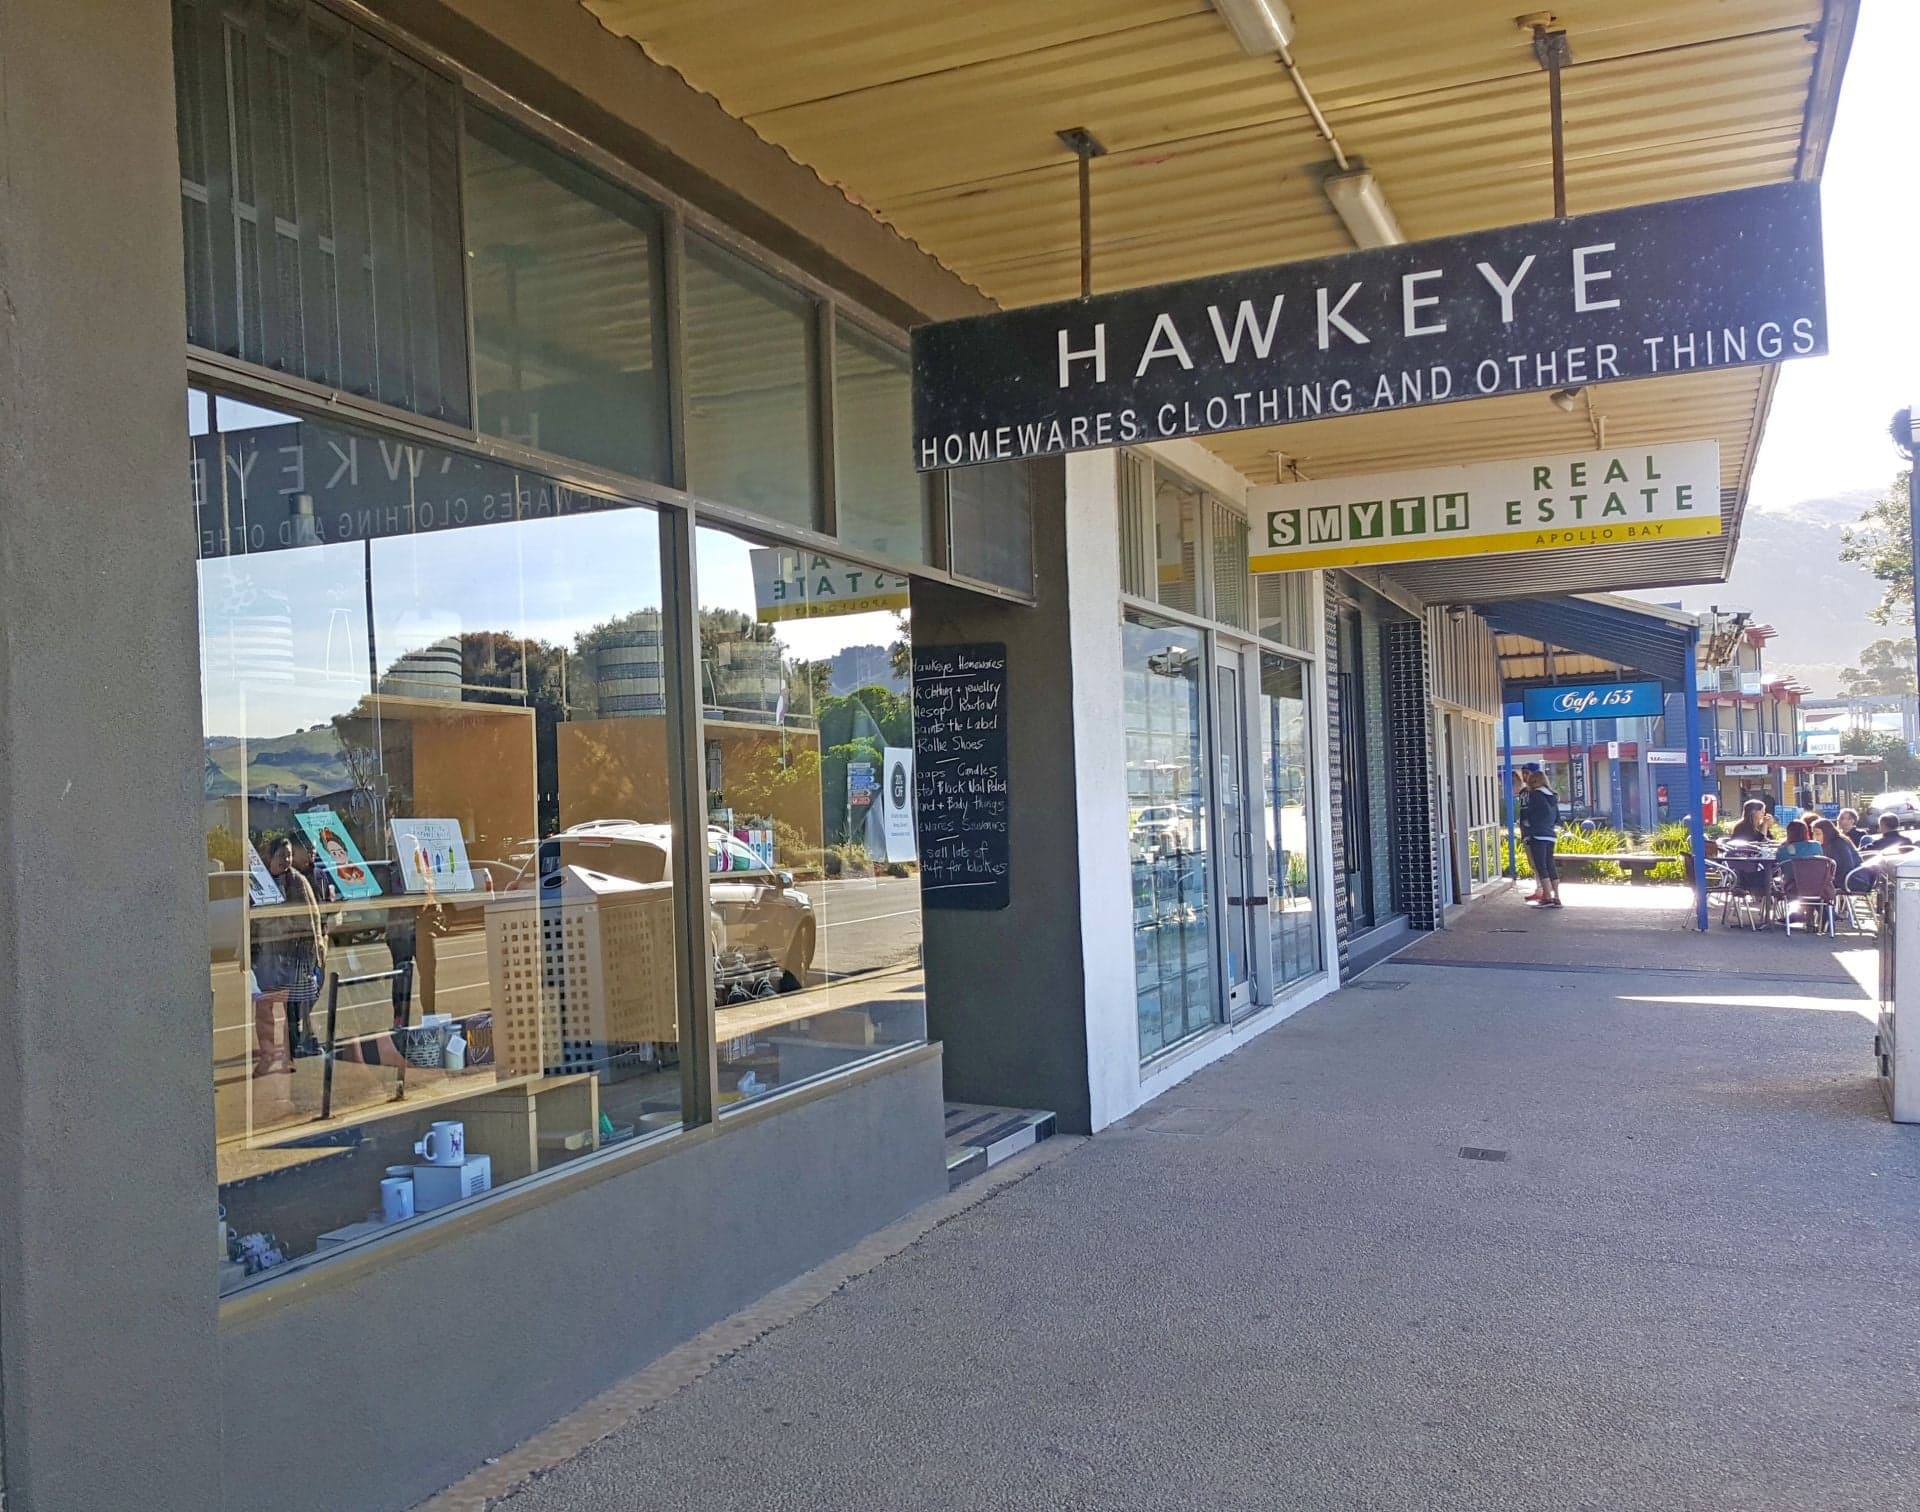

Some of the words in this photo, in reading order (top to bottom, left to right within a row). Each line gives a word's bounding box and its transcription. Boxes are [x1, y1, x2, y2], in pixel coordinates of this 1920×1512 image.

[1057, 242, 1621, 389] HAWKEYE
[921, 409, 1138, 468] HOMEWARES
[1157, 378, 1353, 437] CLOTHING
[1373, 365, 1453, 408] AND
[1476, 343, 1621, 394] OTHER
[1642, 317, 1816, 373] THINGS
[1532, 455, 1662, 492] REAL
[1266, 491, 1470, 549] SMYTH
[1506, 484, 1693, 526] ESTATE
[1535, 527, 1614, 545] APOLLO
[1627, 523, 1664, 538] BAY
[1553, 690, 1600, 714] Cafe
[1602, 689, 1635, 706] 153
